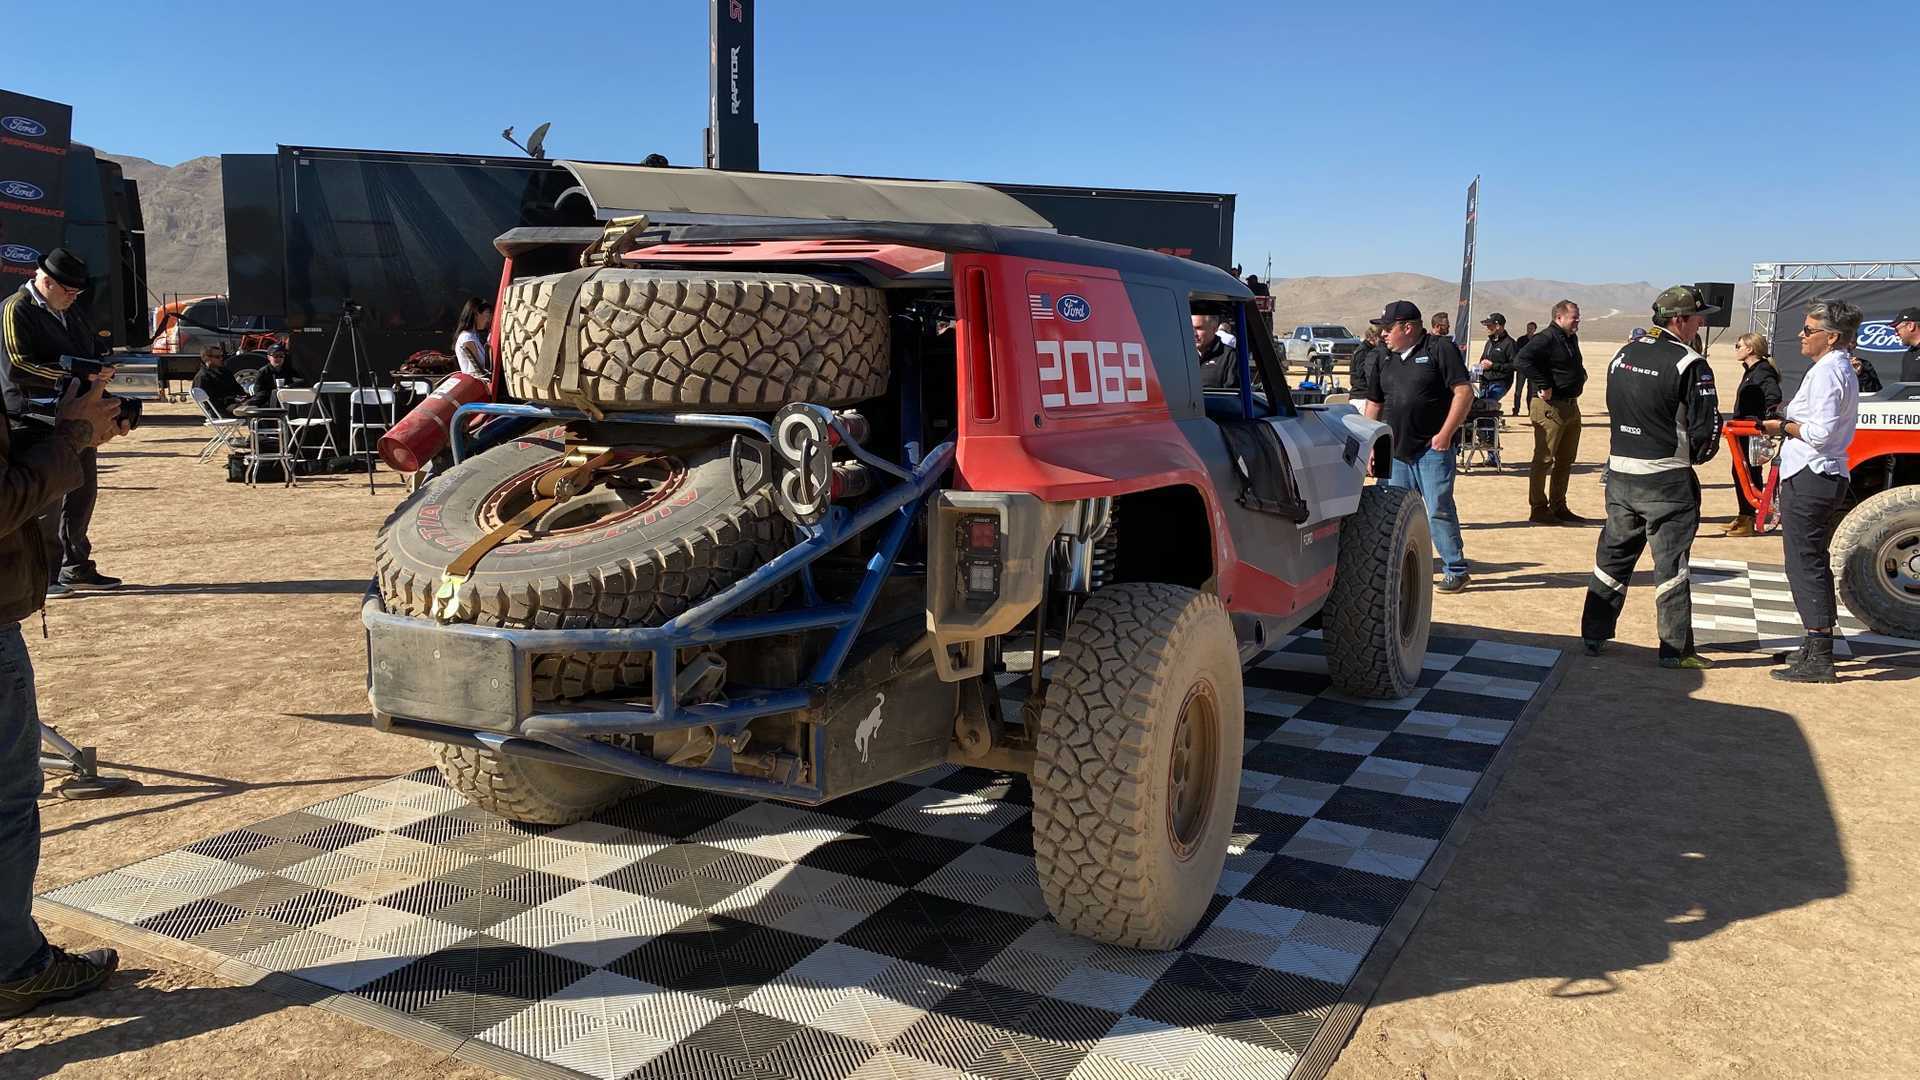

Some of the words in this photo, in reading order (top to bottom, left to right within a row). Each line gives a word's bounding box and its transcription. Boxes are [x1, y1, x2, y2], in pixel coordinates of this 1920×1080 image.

[731, 46, 740, 114] RAPTOR
[6, 183, 36, 198] Ford
[1063, 298, 1085, 318] Ford
[1857, 324, 1902, 346] For
[1036, 340, 1148, 408] 2069
[1620, 363, 1659, 376] BRONCO
[1882, 414, 1920, 424] TREND
